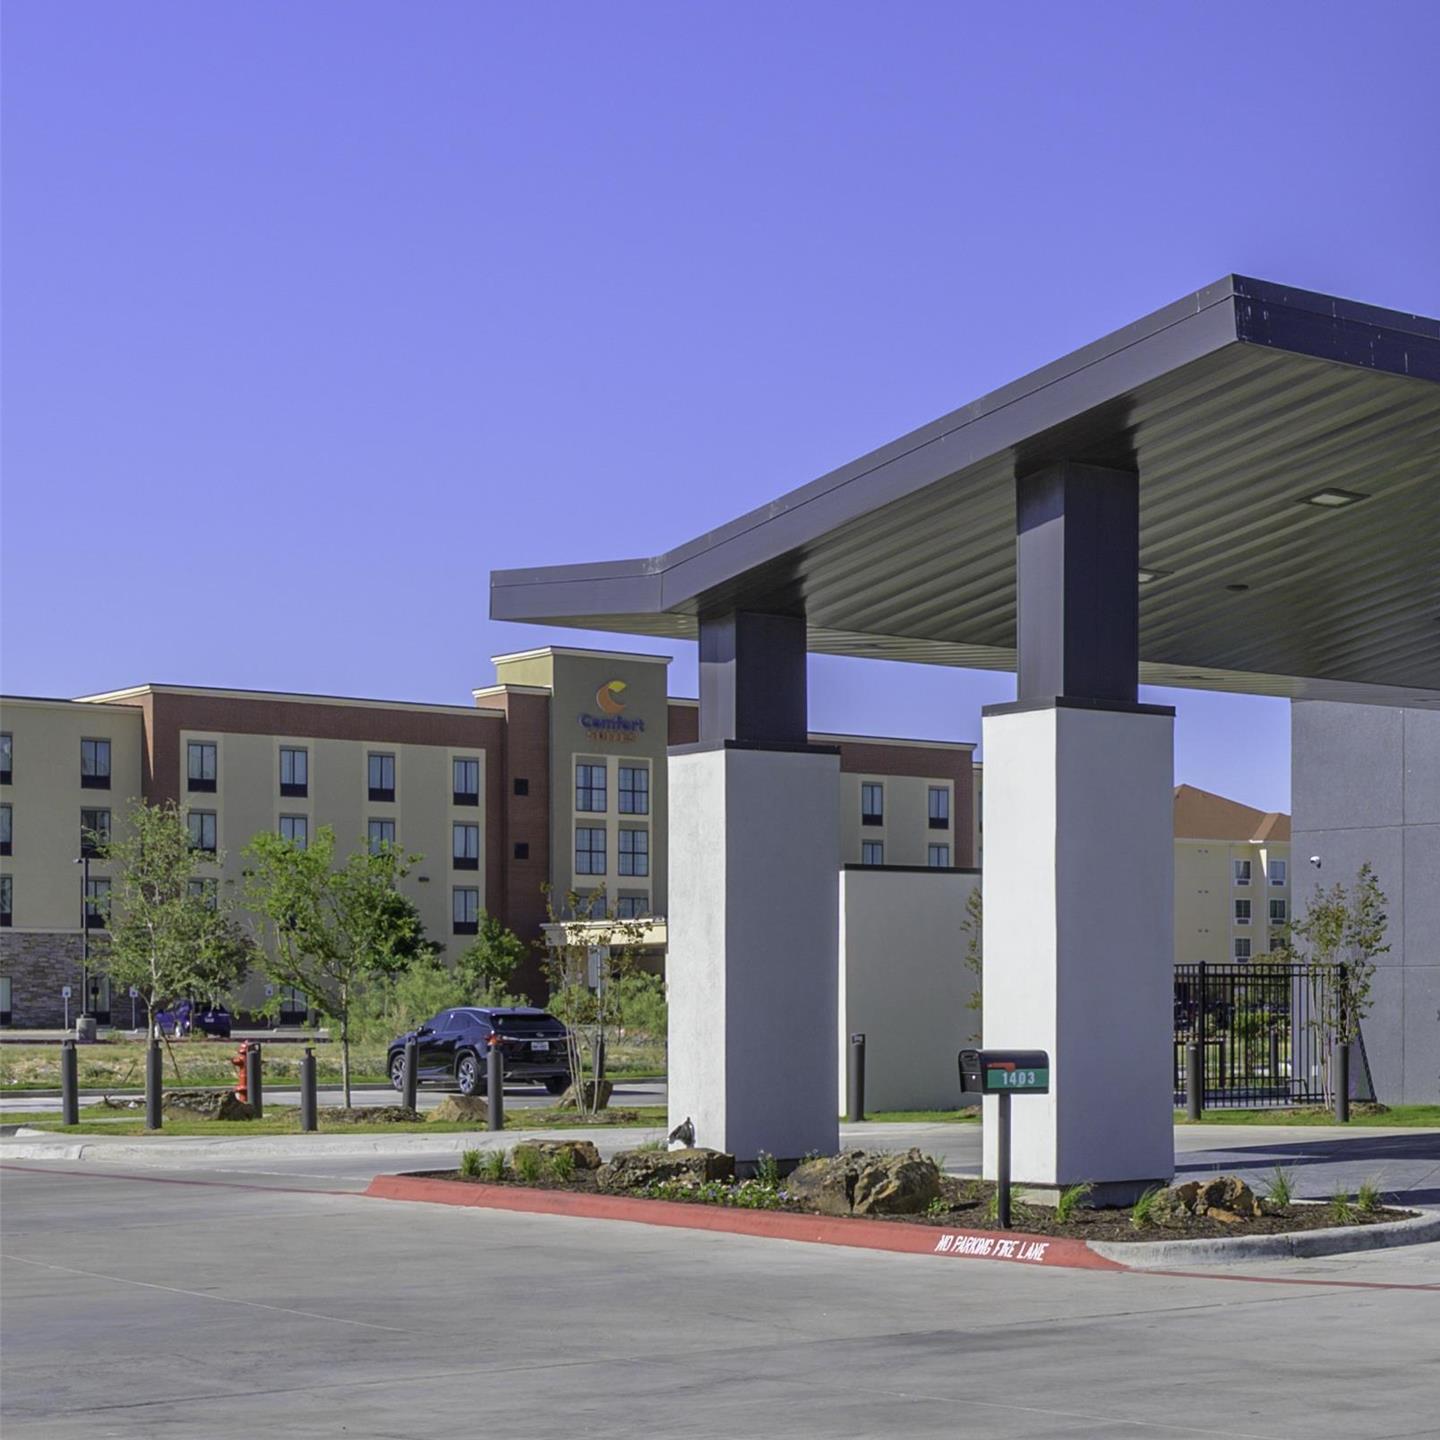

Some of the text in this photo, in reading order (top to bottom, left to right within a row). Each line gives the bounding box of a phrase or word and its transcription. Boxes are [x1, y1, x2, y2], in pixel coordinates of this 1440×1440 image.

[1002, 1071, 1036, 1085] 1403
[934, 1235, 1050, 1261] NO PARKING FIRE LANE
